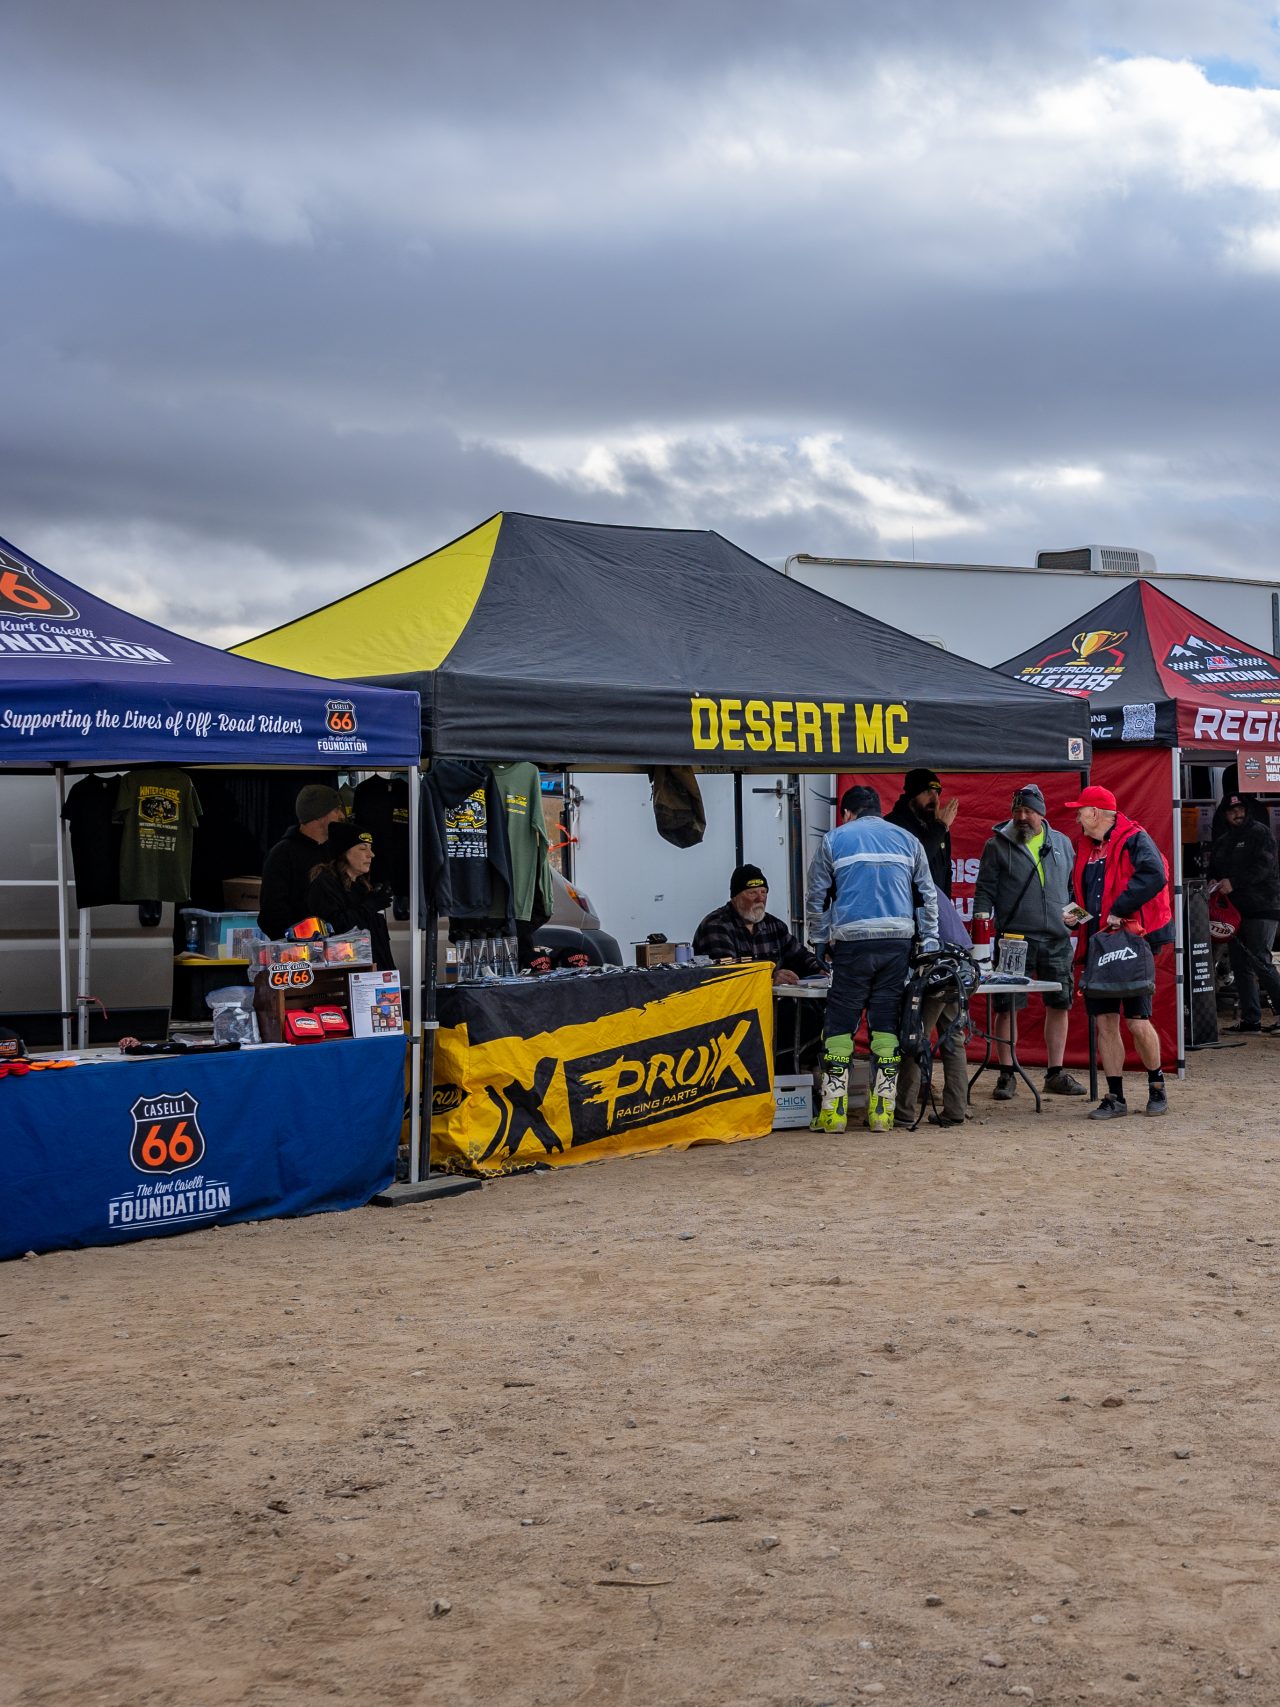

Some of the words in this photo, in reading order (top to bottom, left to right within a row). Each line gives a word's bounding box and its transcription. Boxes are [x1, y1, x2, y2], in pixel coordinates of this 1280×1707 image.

[0, 572, 51, 610] 6
[40, 622, 97, 639] Caselli
[0, 634, 172, 662] NDATION
[1192, 670, 1279, 683] NATIONAL
[0, 709, 92, 736] Supporting
[95, 709, 120, 728] the
[122, 710, 162, 730] Lives
[165, 711, 183, 737] of
[186, 712, 256, 738] Off-Road
[258, 715, 303, 734] Riders
[330, 713, 354, 730] 66
[691, 698, 846, 753] DESERT
[854, 703, 909, 754] MC
[317, 741, 368, 752] FOUNDATION
[293, 969, 310, 984] 66
[144, 1100, 185, 1117] CASELLI
[616, 1099, 660, 1120] RACING
[662, 1087, 698, 1107] PARTS
[142, 1121, 194, 1167] 66
[137, 1183, 153, 1198] The
[154, 1180, 173, 1196] Kurt
[174, 1175, 205, 1192] Caselli
[109, 1186, 231, 1225] FOUNDATION
